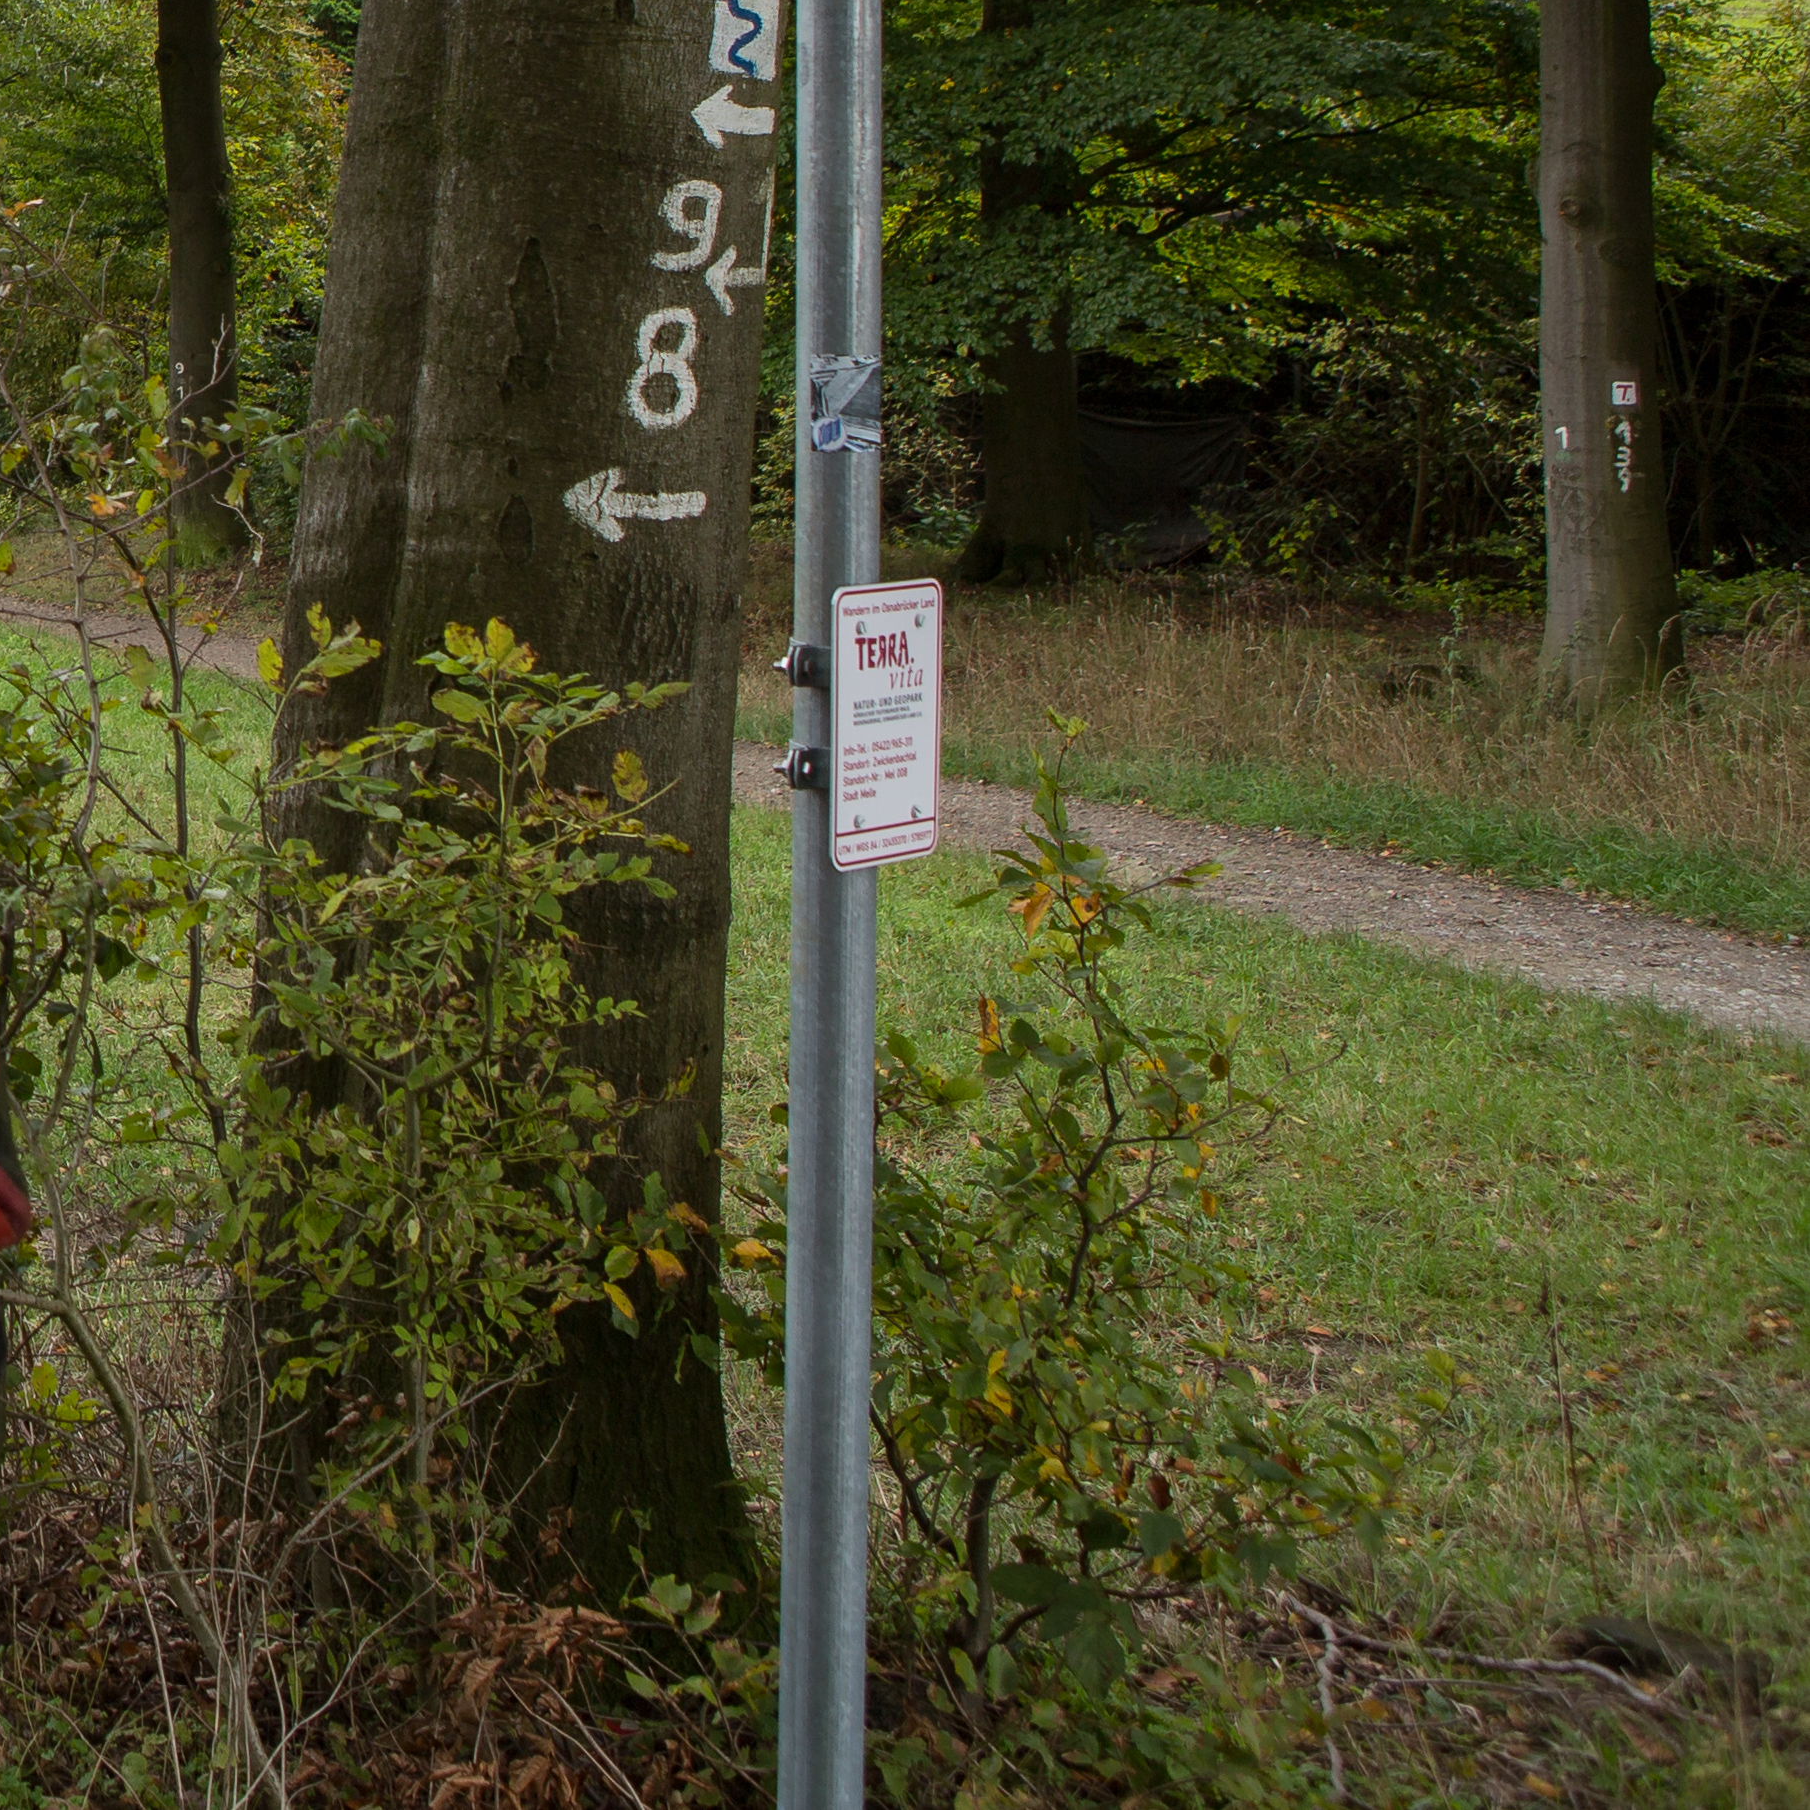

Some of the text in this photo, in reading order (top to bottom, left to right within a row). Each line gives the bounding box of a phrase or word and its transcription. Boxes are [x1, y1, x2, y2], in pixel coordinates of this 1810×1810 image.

[650, 180, 722, 271] 9
[175, 362, 184, 374] 9
[628, 308, 698, 430] 8
[176, 385, 183, 399] 1
[842, 598, 934, 617] Wandern im Osnabrücker Land
[890, 666, 923, 690] vita
[853, 693, 922, 710] NATUR- UND GEOPARK
